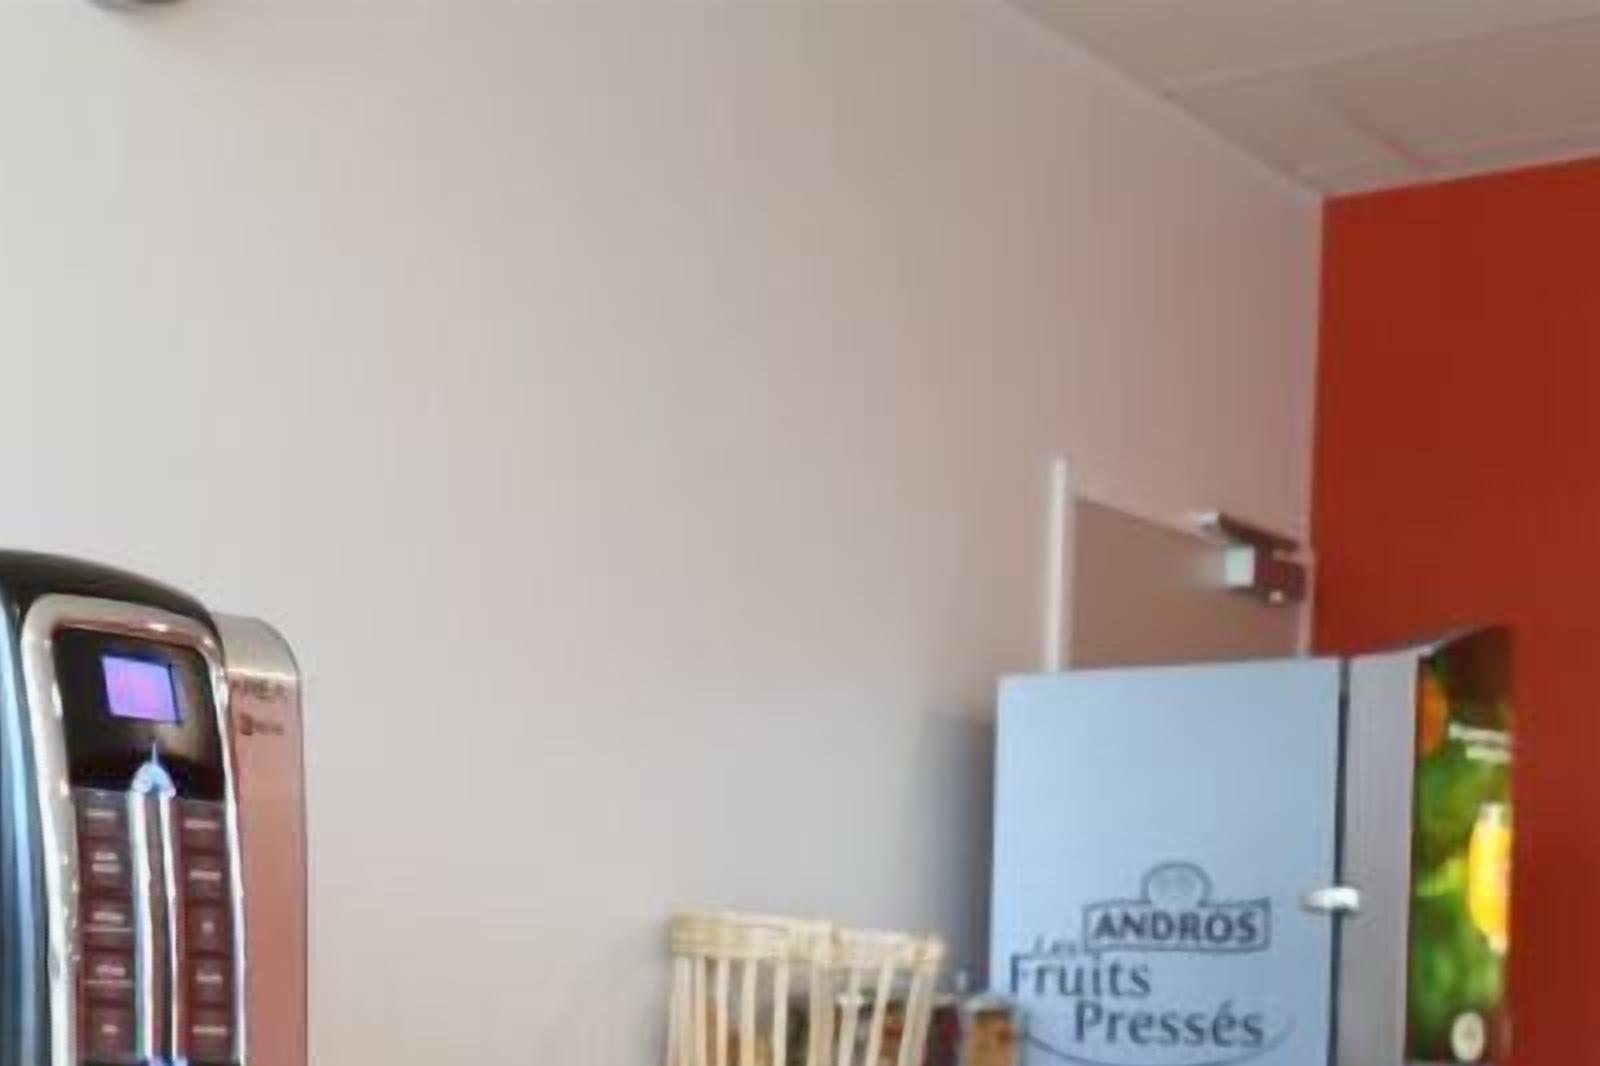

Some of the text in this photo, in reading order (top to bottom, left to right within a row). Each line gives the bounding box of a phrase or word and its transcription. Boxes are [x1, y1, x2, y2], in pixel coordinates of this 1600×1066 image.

[1095, 910, 1257, 943] ANDROS
[1010, 951, 1151, 997] Fruits
[1075, 999, 1264, 1048] Pressés
